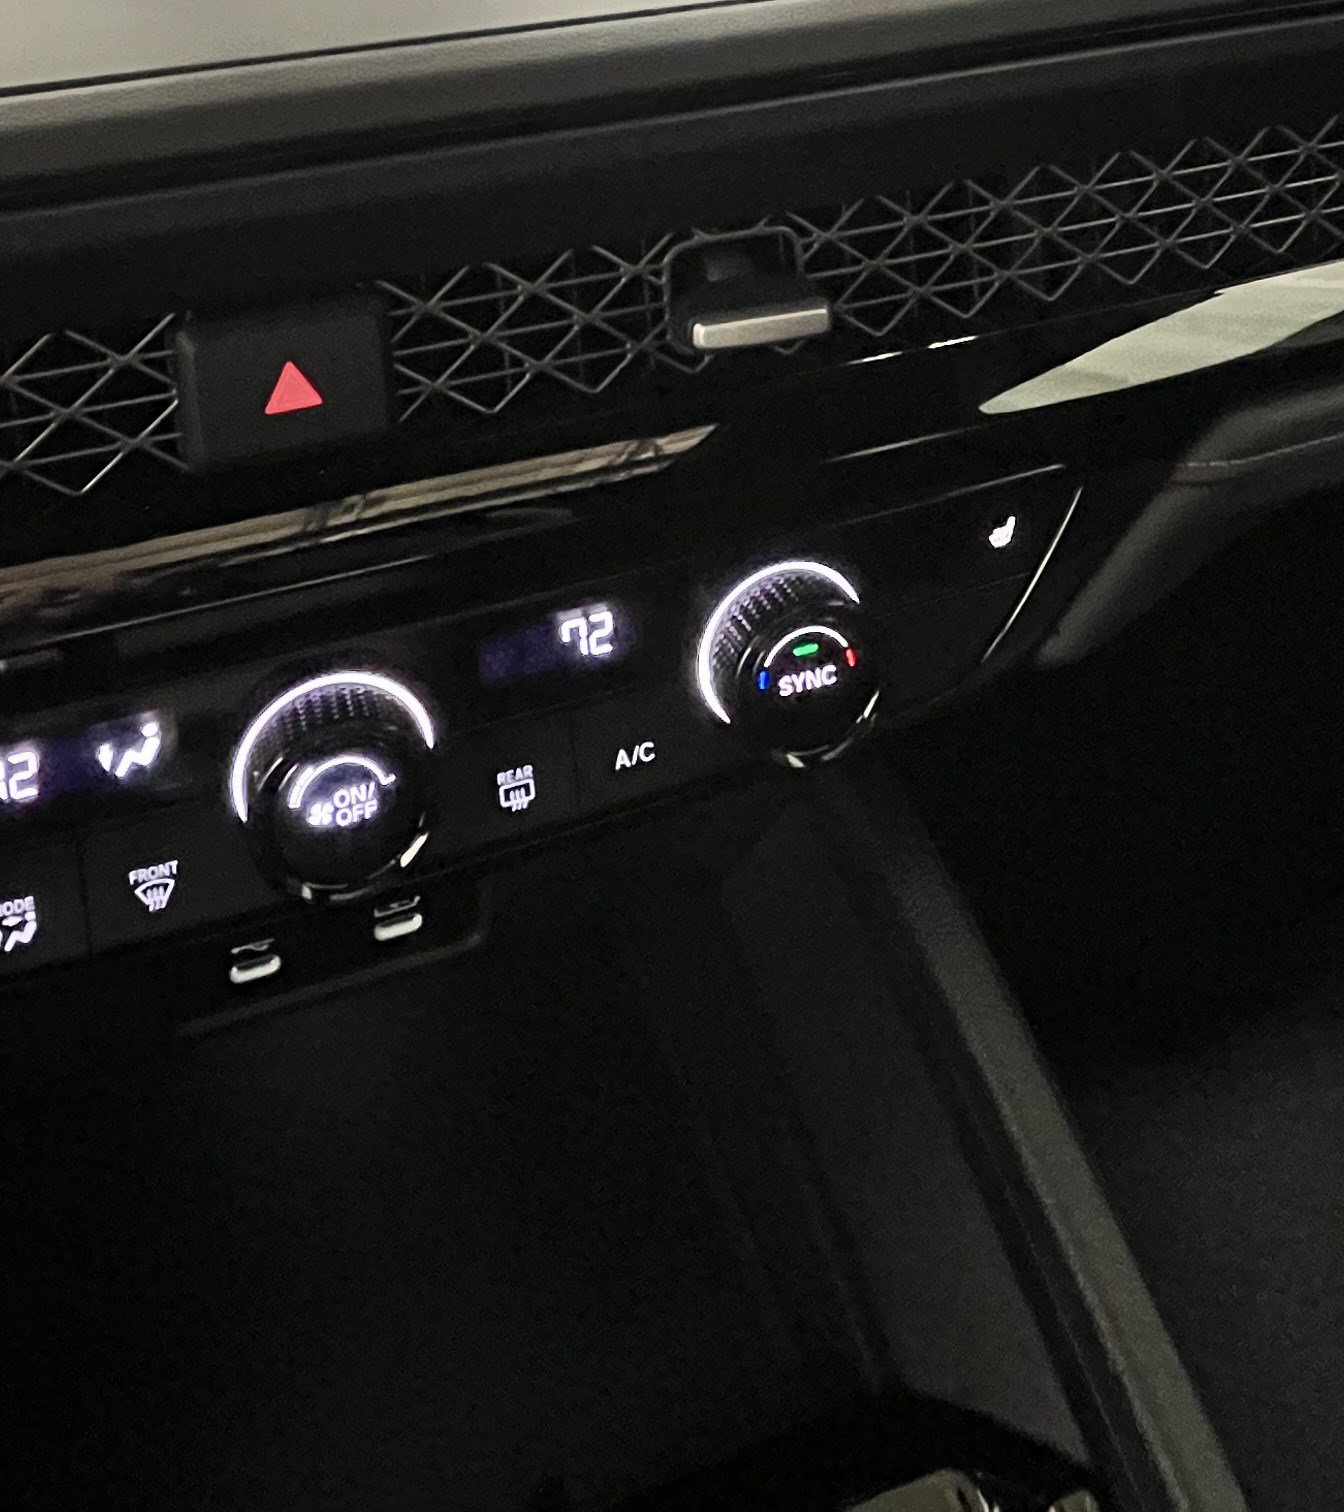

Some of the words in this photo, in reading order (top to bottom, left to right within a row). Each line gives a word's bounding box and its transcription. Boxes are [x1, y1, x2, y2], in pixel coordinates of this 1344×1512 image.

[560, 611, 615, 657] 72
[778, 665, 838, 698] SYNC
[615, 741, 656, 771] A/C
[498, 765, 533, 786] REAR
[334, 783, 375, 807] ON/
[335, 800, 379, 827] OFF
[128, 860, 180, 885] FRONT
